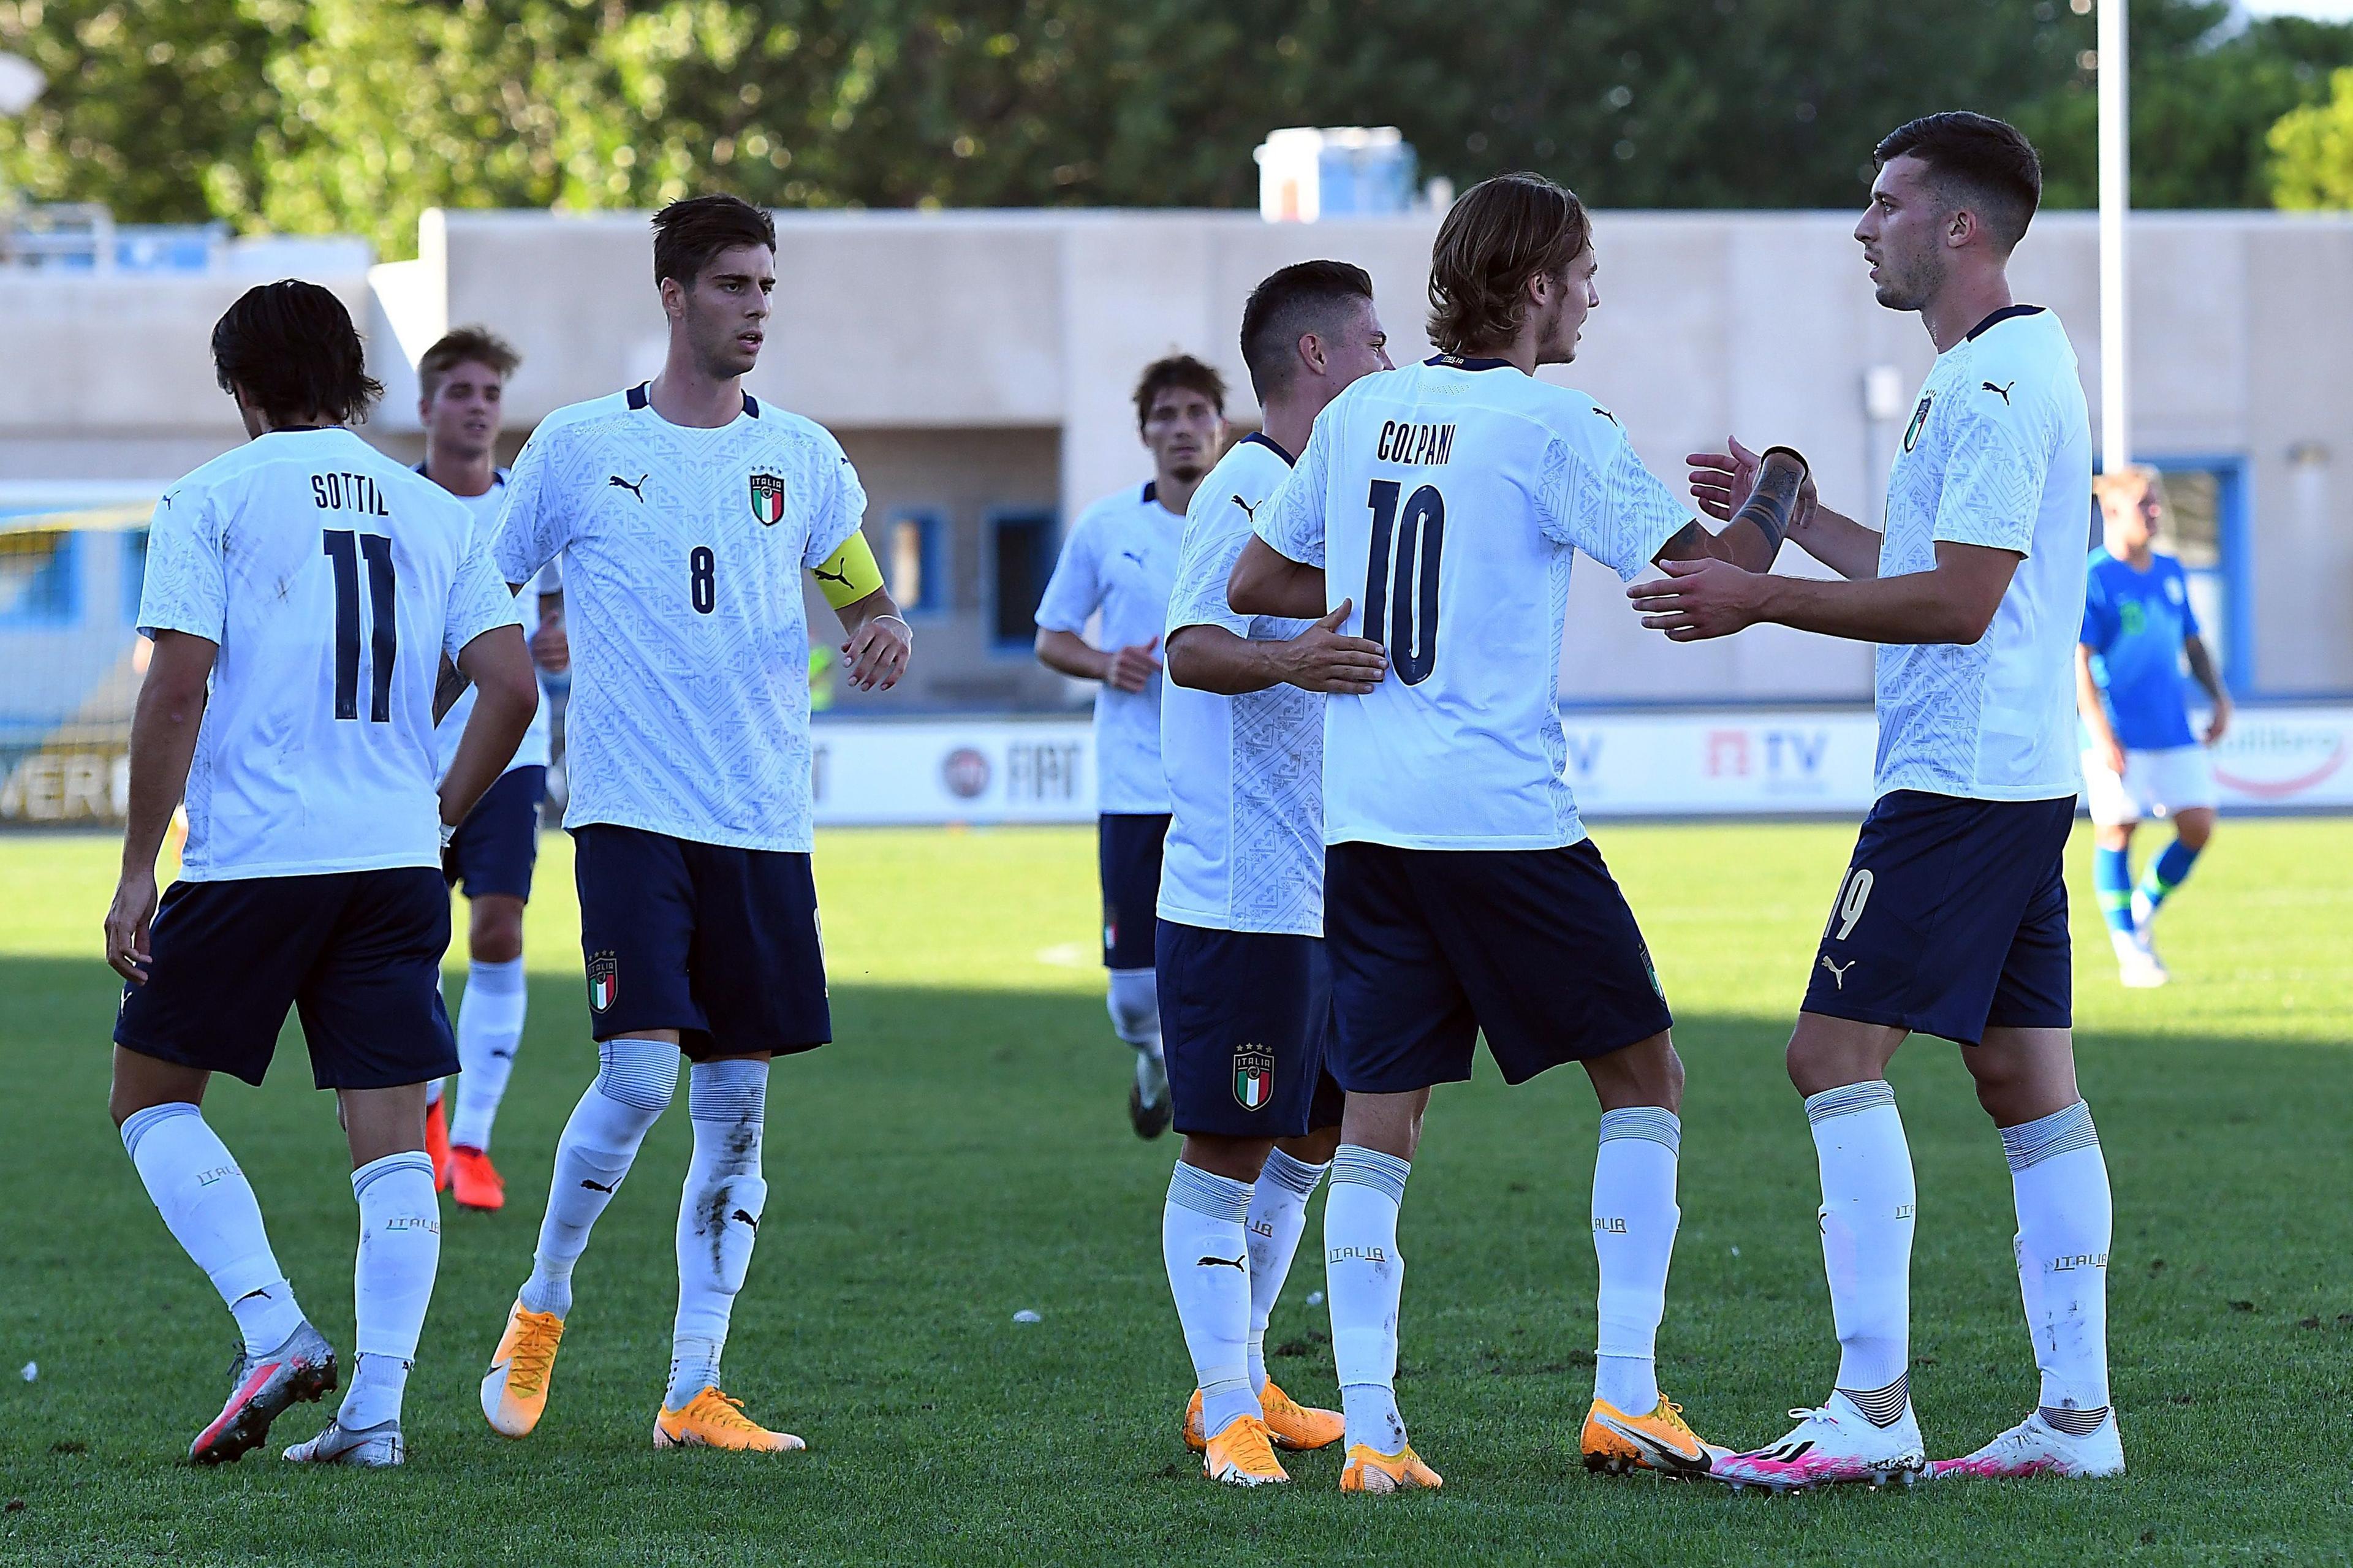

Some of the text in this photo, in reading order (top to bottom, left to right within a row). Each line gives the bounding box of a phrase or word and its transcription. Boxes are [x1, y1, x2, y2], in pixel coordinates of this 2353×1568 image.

[1442, 355, 1464, 365] ITALIA
[1377, 420, 1457, 465] COLPANI
[311, 472, 389, 516] SOTTIL
[752, 477, 781, 489] ITALIA
[691, 546, 714, 614] 8
[1362, 479, 1445, 686] 10
[322, 529, 396, 722] 11
[1824, 866, 1874, 941] 19
[589, 962, 613, 975] ITALIA
[1237, 1057, 1270, 1067] ITALIA
[1329, 1246, 1384, 1262] ITALIA
[2055, 1253, 2107, 1268] ITALIA
